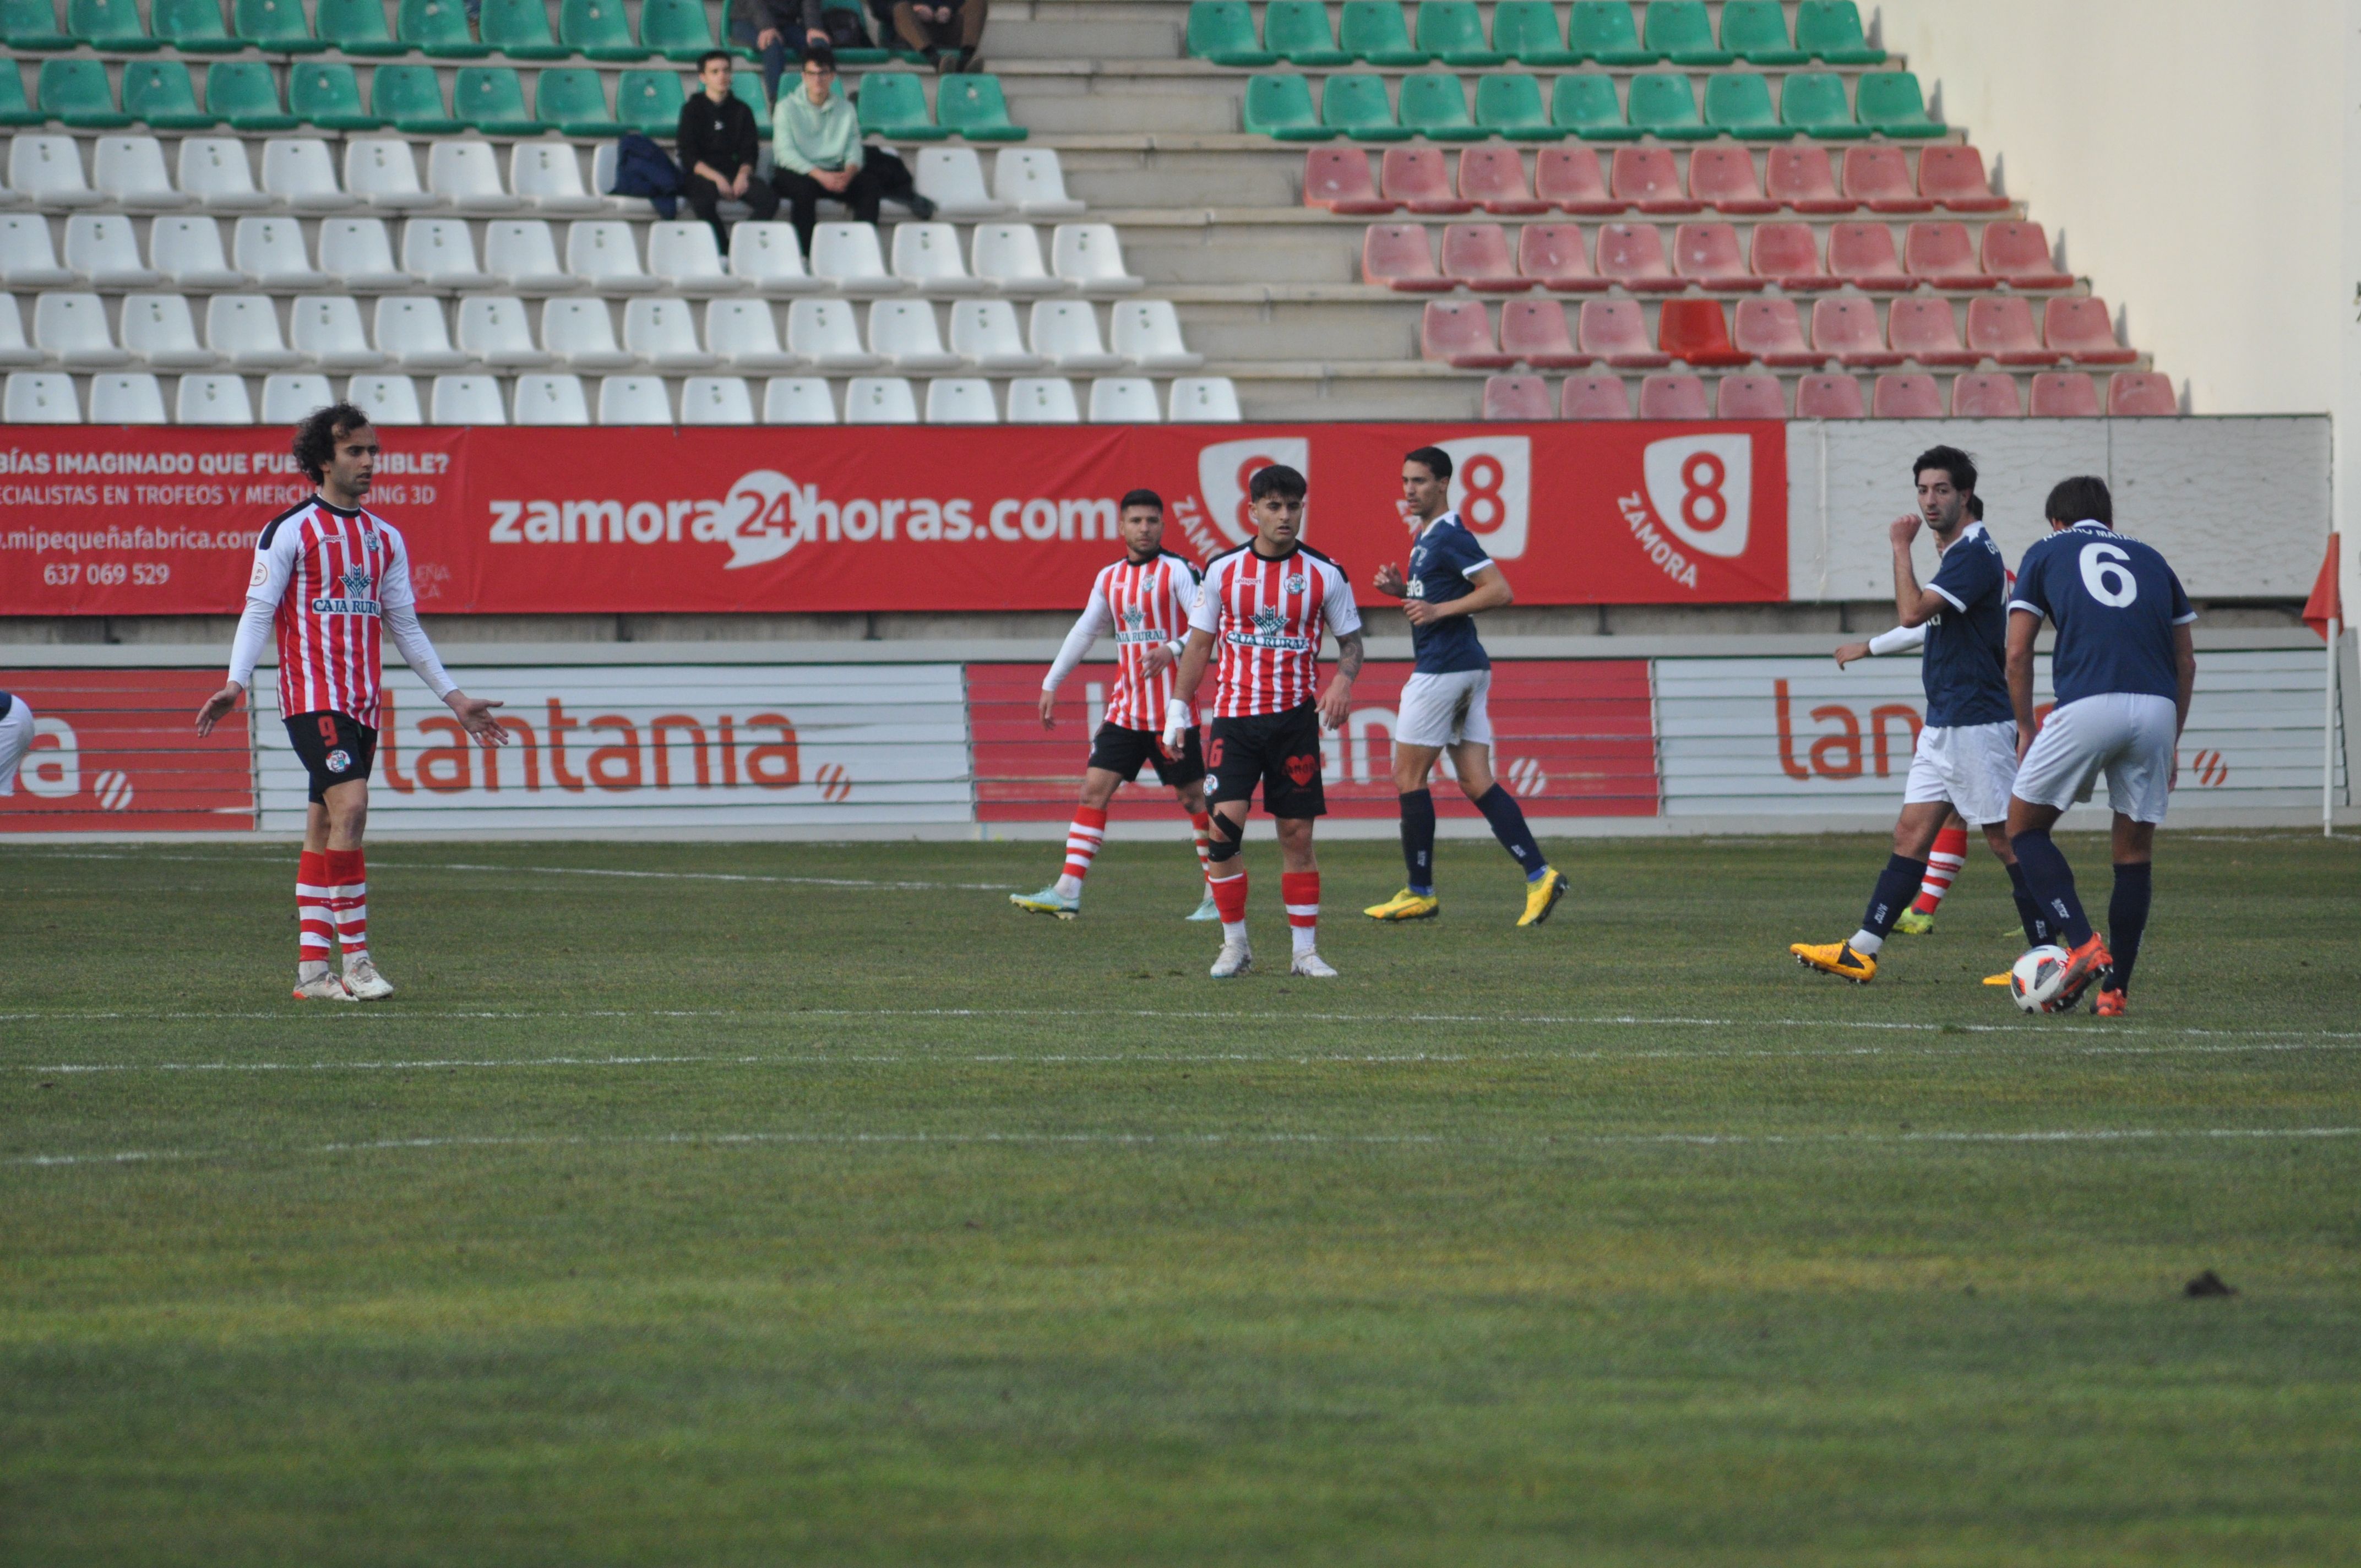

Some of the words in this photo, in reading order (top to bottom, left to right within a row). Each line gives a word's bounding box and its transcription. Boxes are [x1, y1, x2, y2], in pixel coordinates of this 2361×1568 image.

[56, 452, 194, 475] IMAGINADO
[198, 452, 248, 476] QUE
[0, 484, 98, 505] CIALISTAS
[103, 484, 130, 505] EN
[134, 484, 224, 505] TROFEOS
[227, 484, 241, 505] Y
[411, 485, 437, 505] 3D
[1461, 453, 1505, 535] 8
[1682, 450, 1727, 532] 8
[0, 525, 261, 554] .mipequeñafabrica.com
[1617, 491, 1698, 590] ZAMORA
[43, 563, 81, 585] 637
[86, 563, 128, 585] 069
[132, 563, 170, 585] 529
[2079, 542, 2137, 608] 6
[313, 599, 349, 613] CAJA
[1226, 631, 1258, 645] CAJA
[1261, 635, 1309, 650] RURAL
[318, 715, 339, 747] 9
[380, 688, 801, 794] lantania
